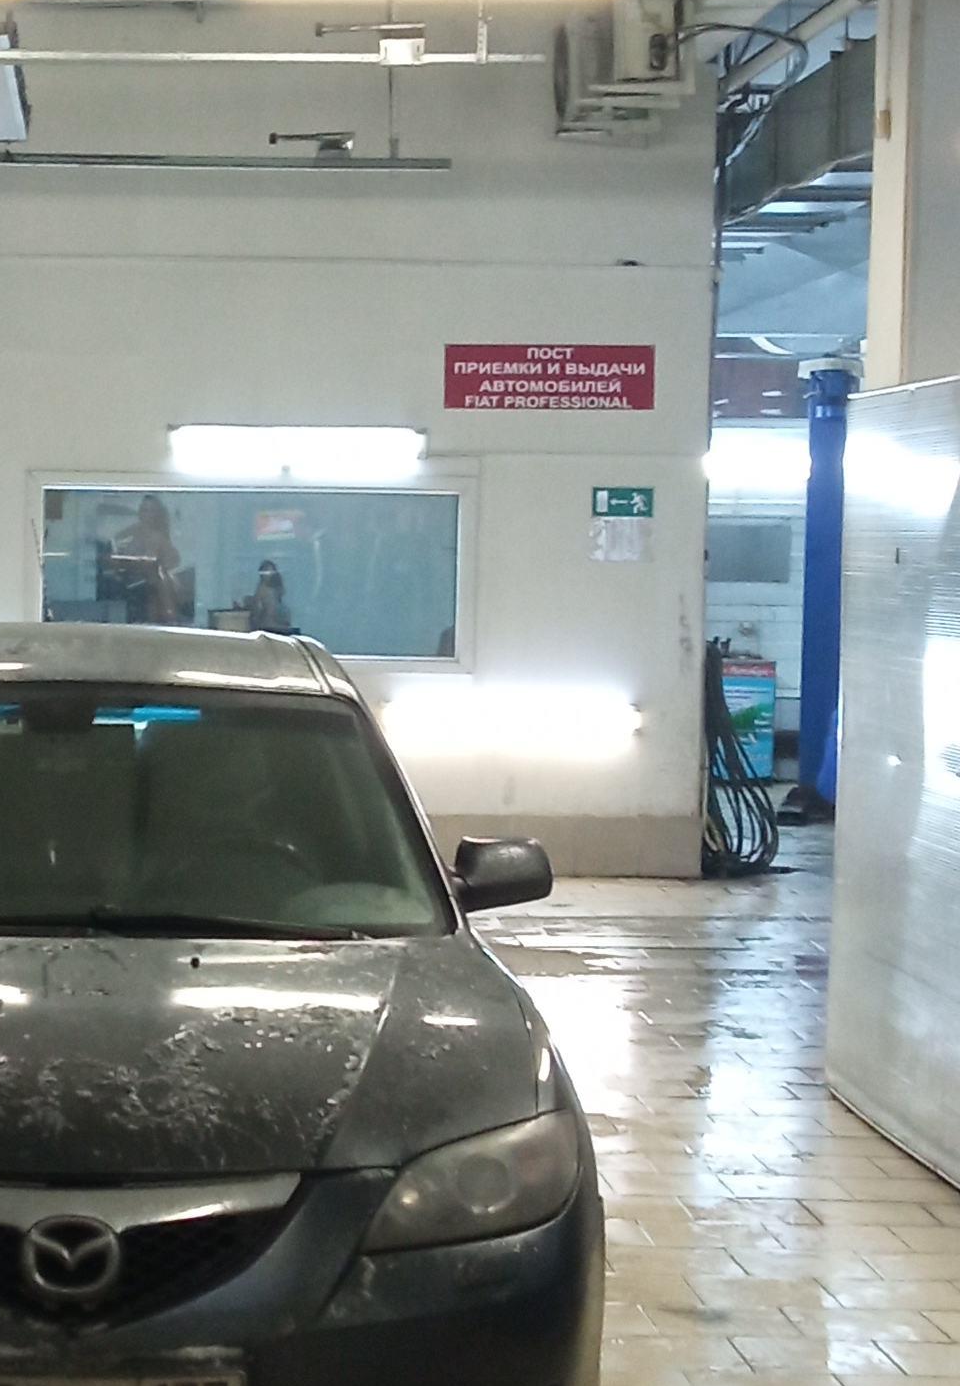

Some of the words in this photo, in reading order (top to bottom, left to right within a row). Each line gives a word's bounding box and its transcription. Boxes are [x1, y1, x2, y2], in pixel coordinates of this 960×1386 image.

[527, 347, 574, 359] ПОСТ
[454, 362, 541, 375] ПРИЕМКИ
[547, 363, 560, 375] И
[565, 363, 645, 376] ВЫДАЧИ
[479, 378, 622, 393] АВТОМОБИЛЕЙ
[465, 396, 499, 408] FIAT
[504, 396, 632, 409] PROFESSIONAL
